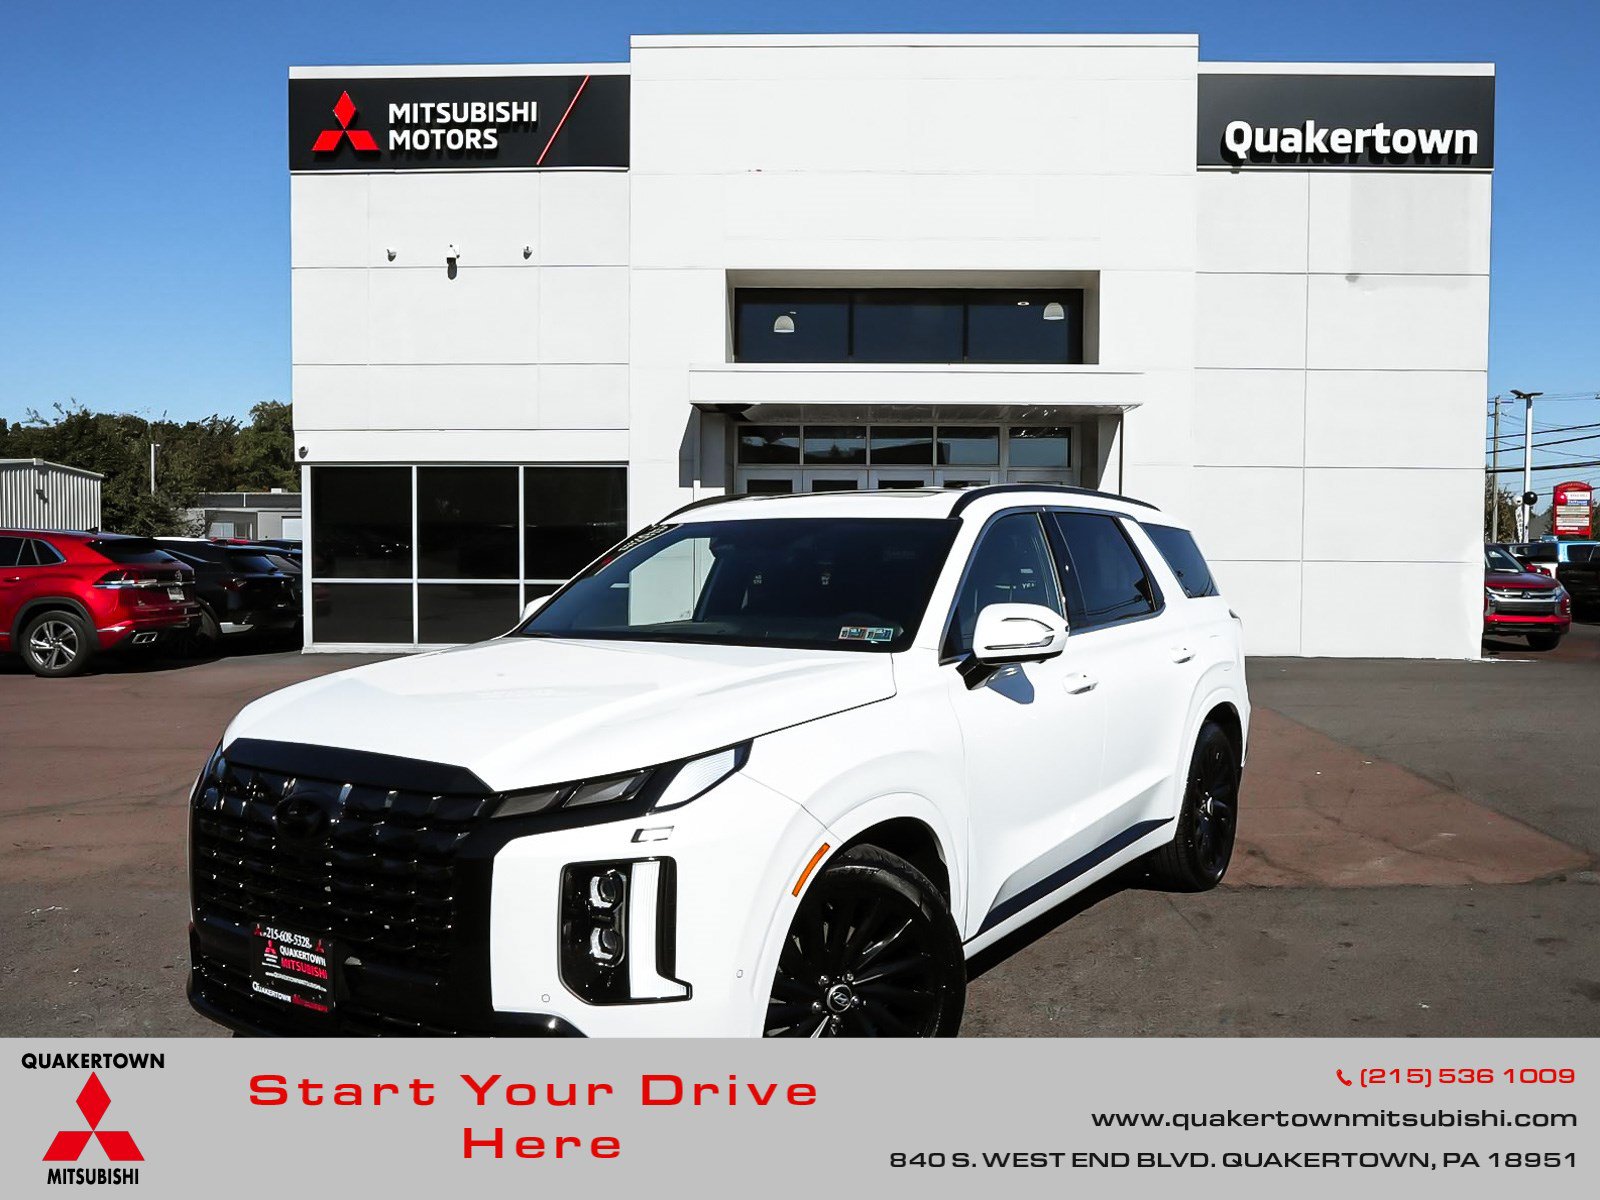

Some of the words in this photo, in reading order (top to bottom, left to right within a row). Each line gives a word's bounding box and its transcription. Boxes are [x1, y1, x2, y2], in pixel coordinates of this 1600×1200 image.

[388, 101, 538, 124] MITSUBISHI
[388, 128, 499, 151] MOTORS
[1225, 120, 1478, 159] Quakertown
[280, 945, 326, 967] QUAKERTOWN
[281, 957, 328, 979] MITSUBISHI
